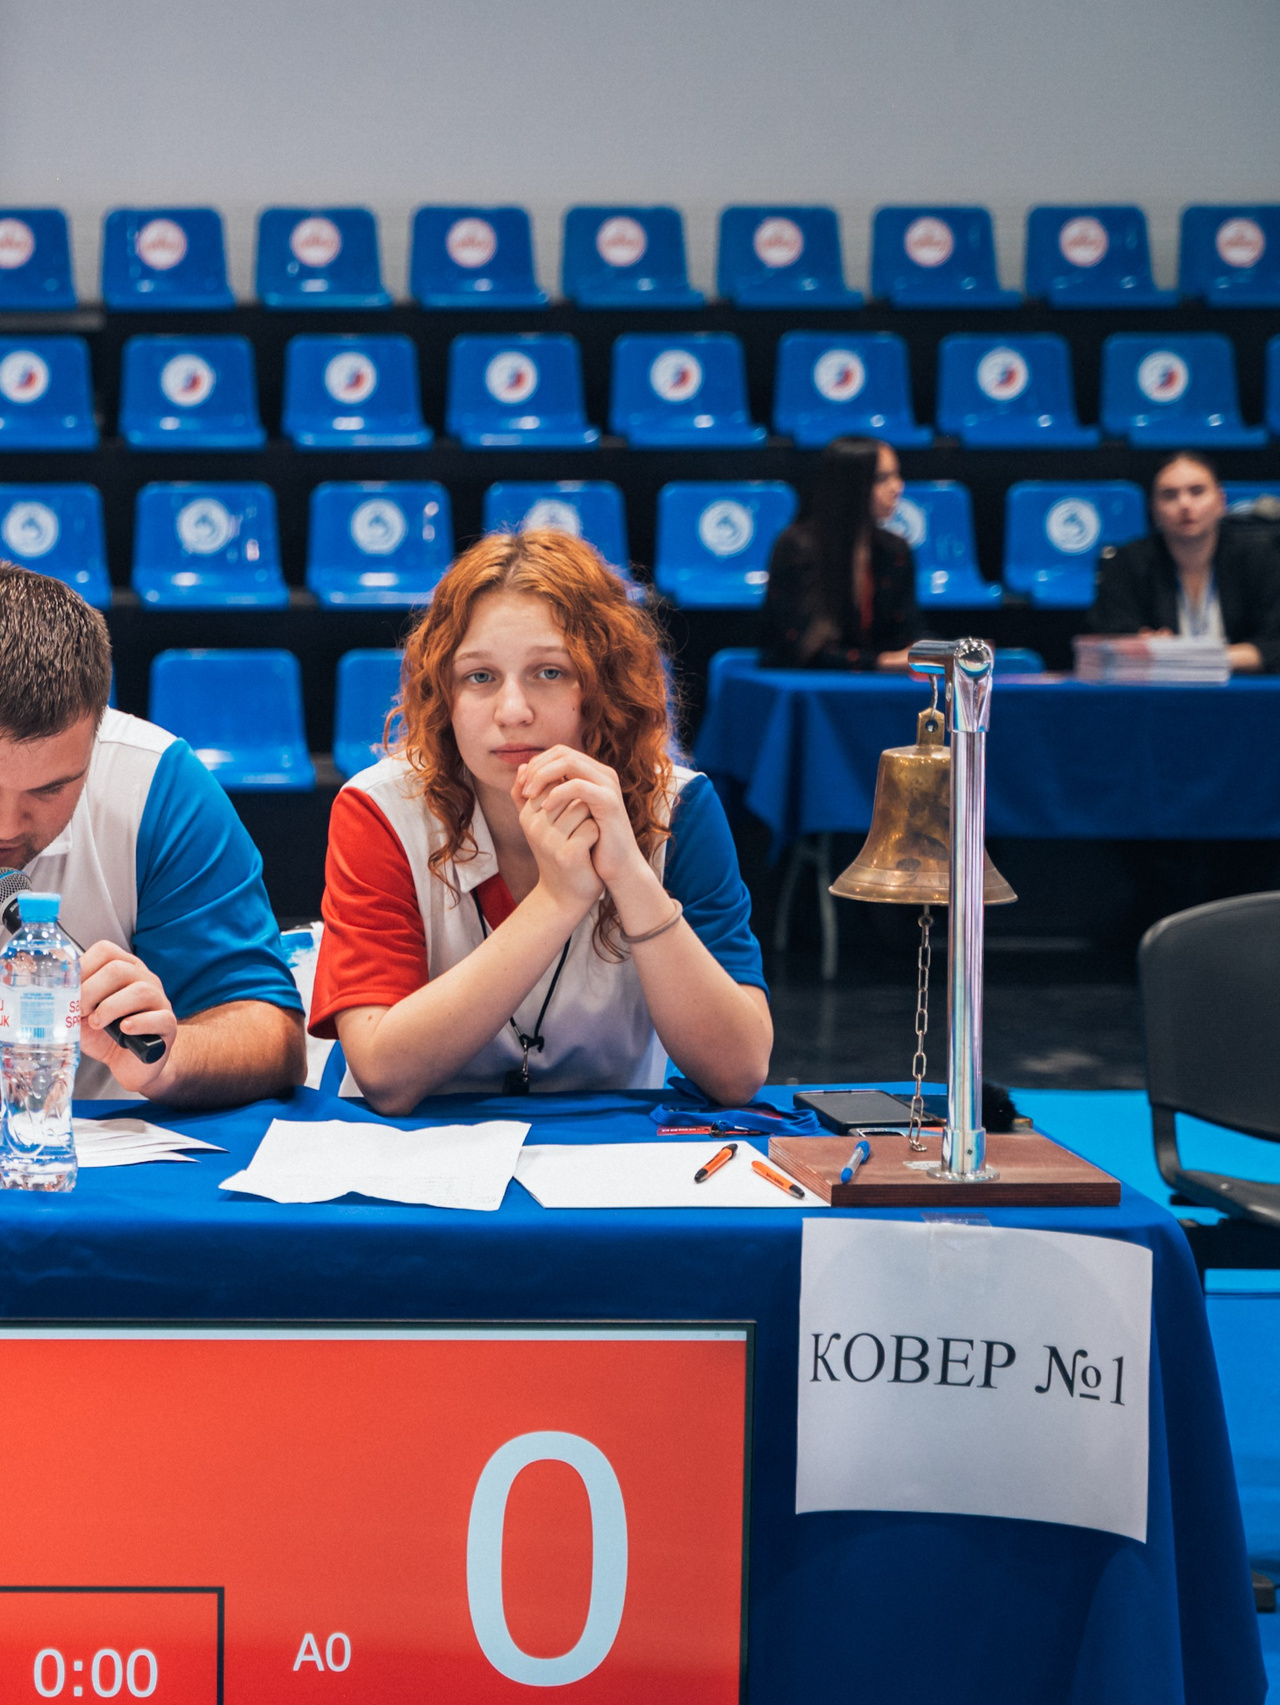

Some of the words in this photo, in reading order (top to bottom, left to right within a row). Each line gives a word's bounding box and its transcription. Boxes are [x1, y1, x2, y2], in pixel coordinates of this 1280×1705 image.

[809, 1332, 1017, 1389] КОВЕР
[1034, 1345, 1126, 1406] №1
[466, 1430, 629, 1688] 0
[33, 1648, 159, 1698] 0:00
[292, 1632, 352, 1672] A0
